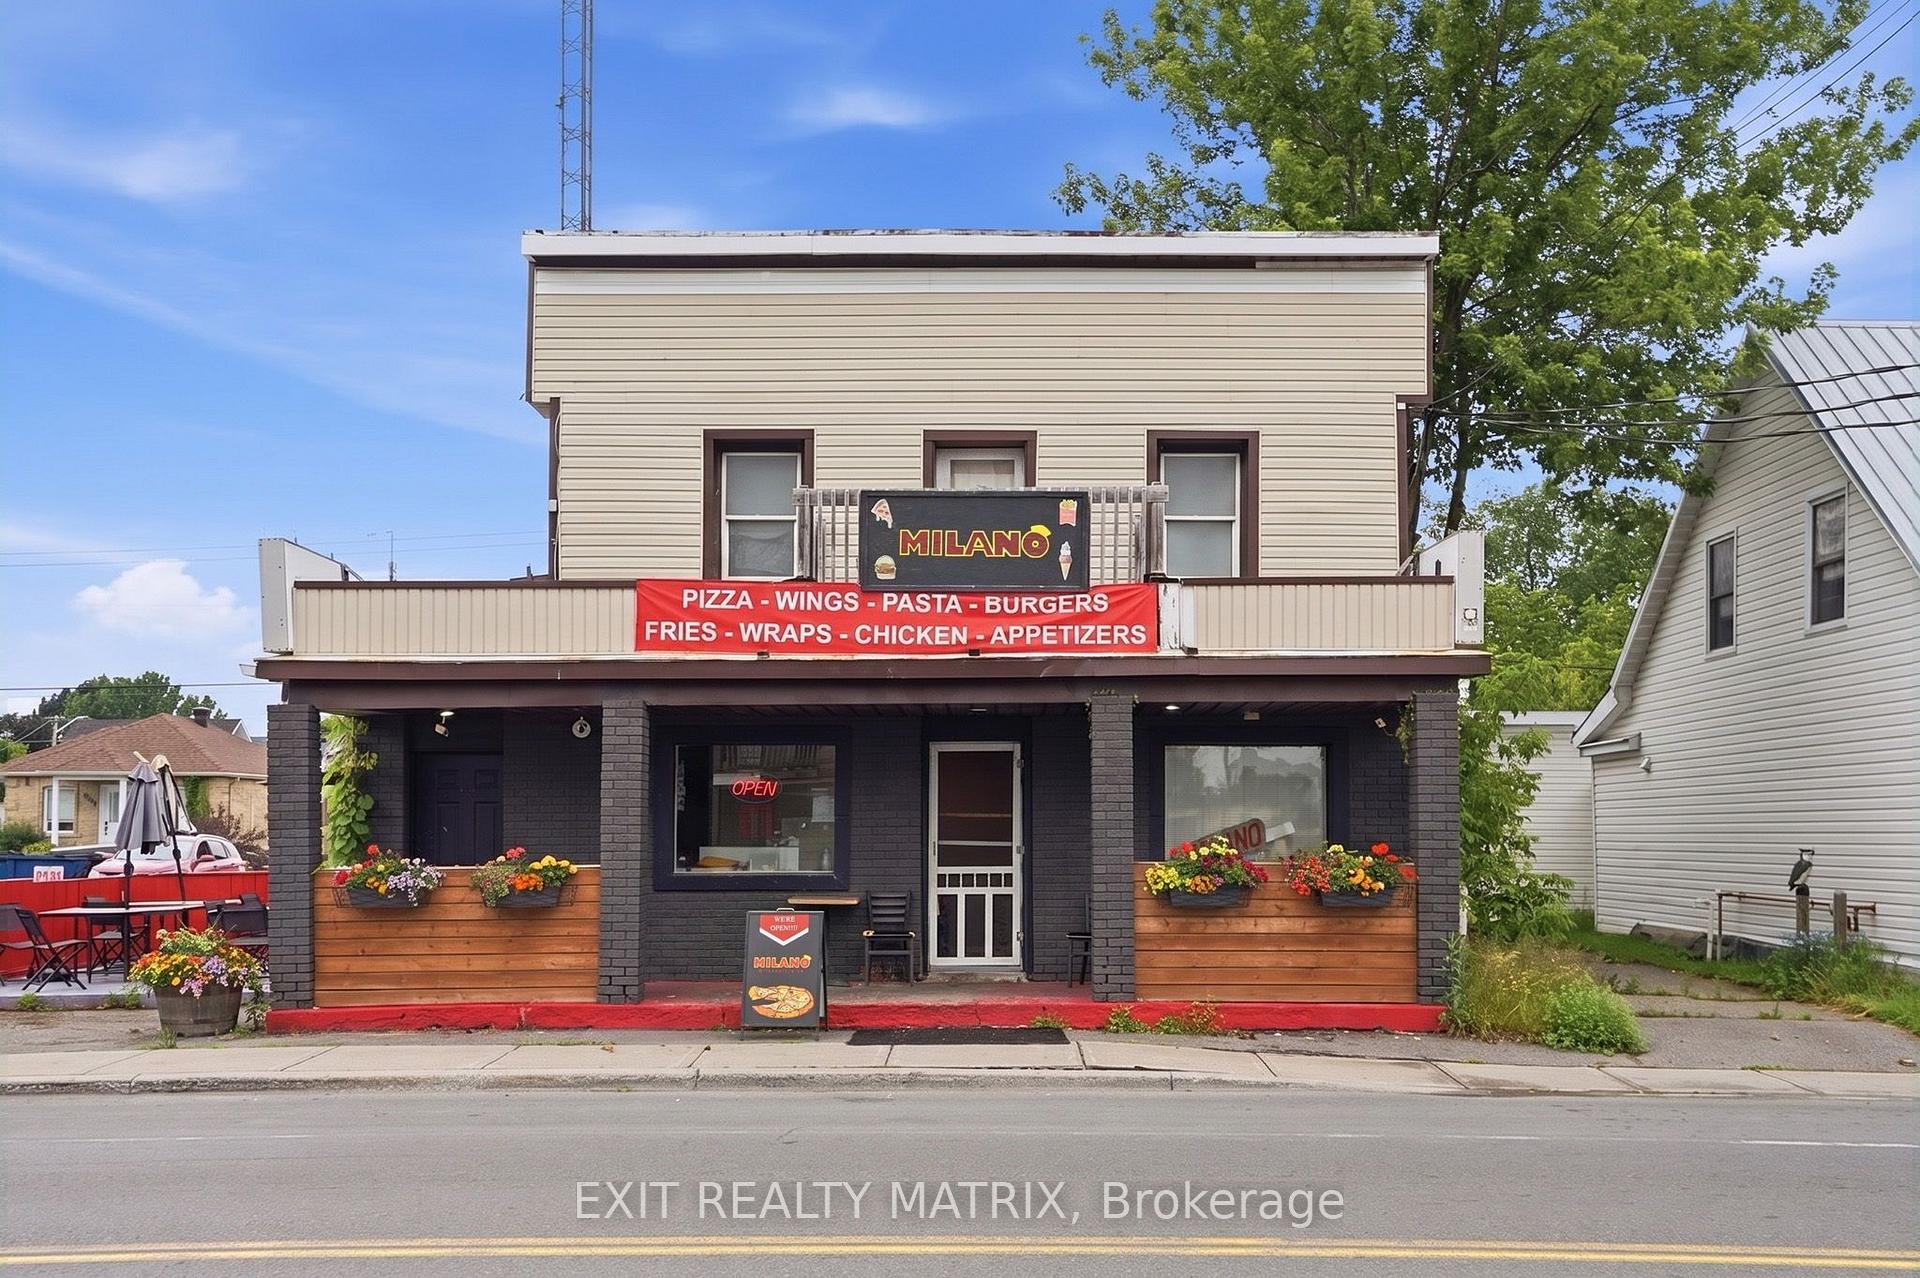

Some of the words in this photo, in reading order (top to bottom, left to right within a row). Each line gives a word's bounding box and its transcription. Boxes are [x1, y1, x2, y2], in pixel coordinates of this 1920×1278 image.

[899, 525, 1051, 558] MILANO
[682, 588, 754, 610] PIZZA
[774, 590, 860, 612] WINGS
[882, 592, 963, 614] PASTA
[984, 593, 1109, 615] BURGERS
[645, 621, 717, 642] FRIES
[739, 622, 832, 644] WRAPS
[854, 624, 968, 645] CHICKEN
[989, 624, 1147, 645] APPETIZERS
[732, 780, 778, 797] OPEN
[753, 956, 811, 969] MILANO
